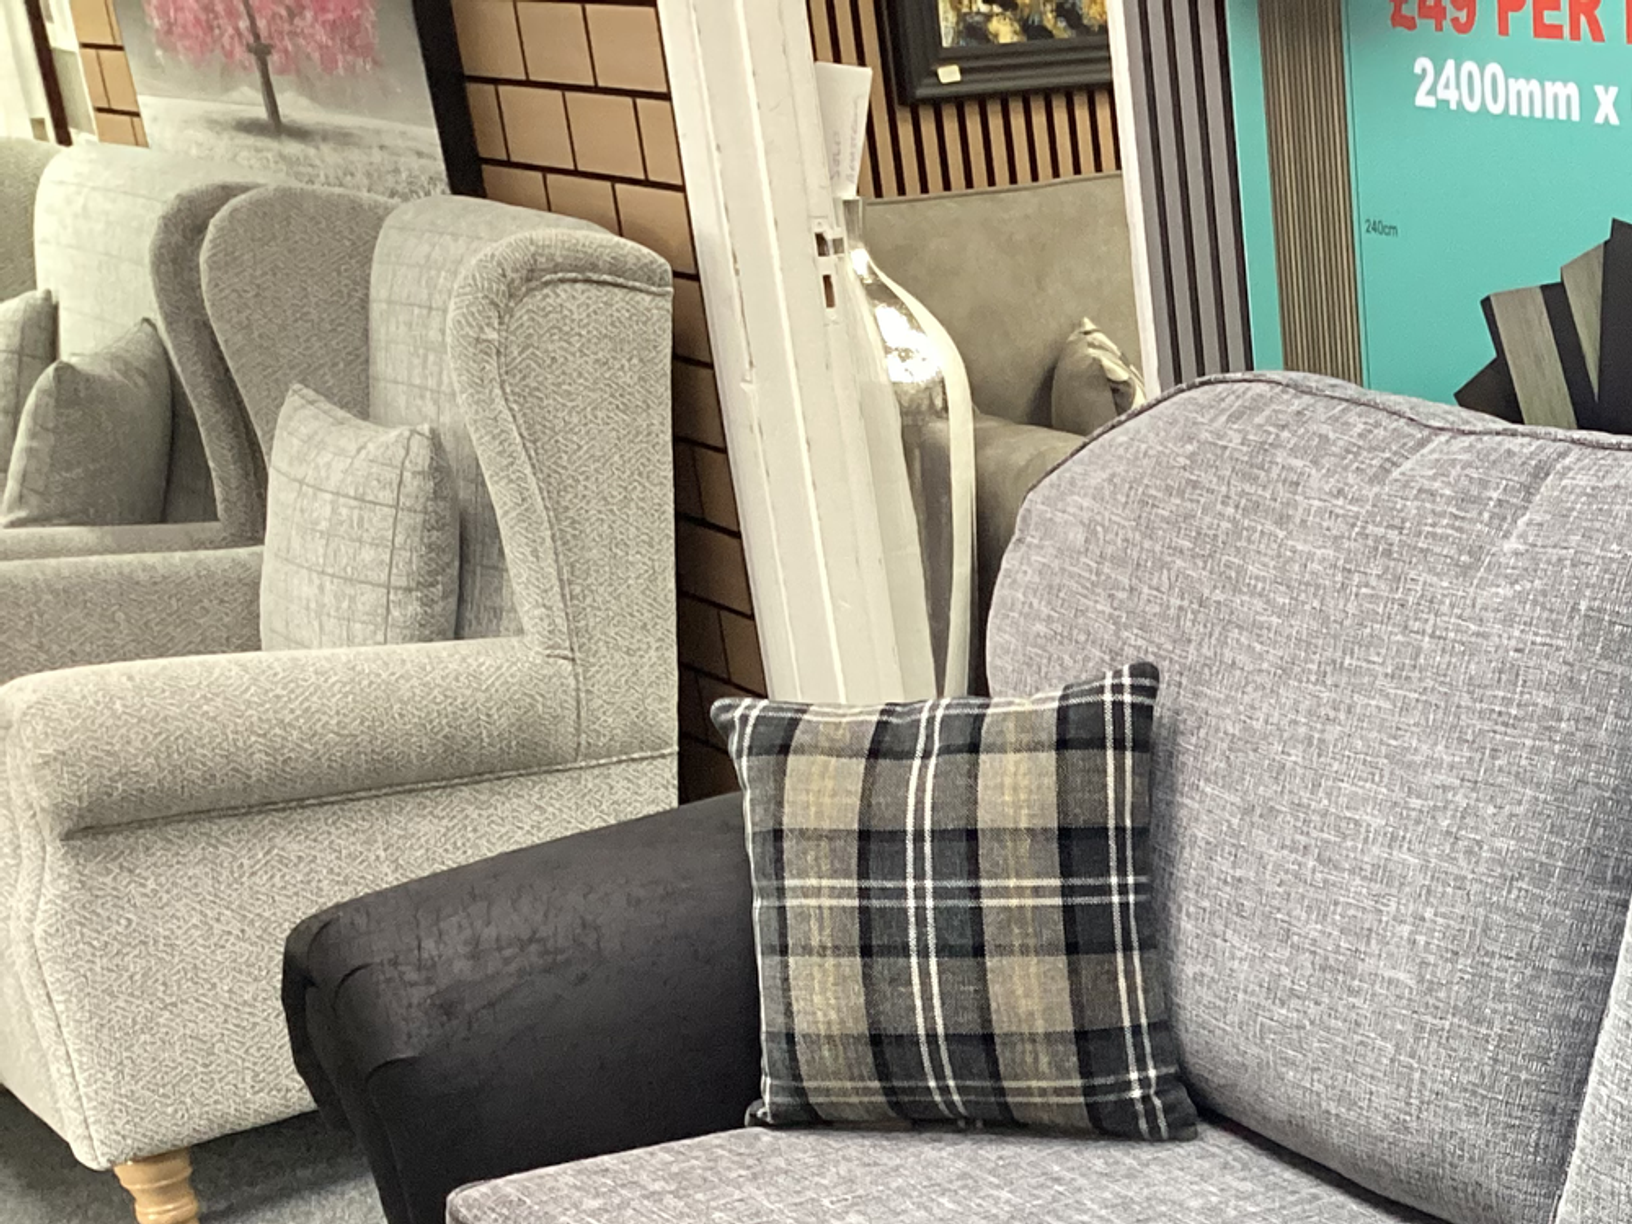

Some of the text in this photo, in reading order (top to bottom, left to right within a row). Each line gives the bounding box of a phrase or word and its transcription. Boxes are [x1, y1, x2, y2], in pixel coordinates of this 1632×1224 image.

[1497, 0, 1605, 43] PER
[1413, 56, 1580, 122] 2400mm
[1594, 83, 1620, 126] x
[1365, 218, 1399, 237] 240cm
